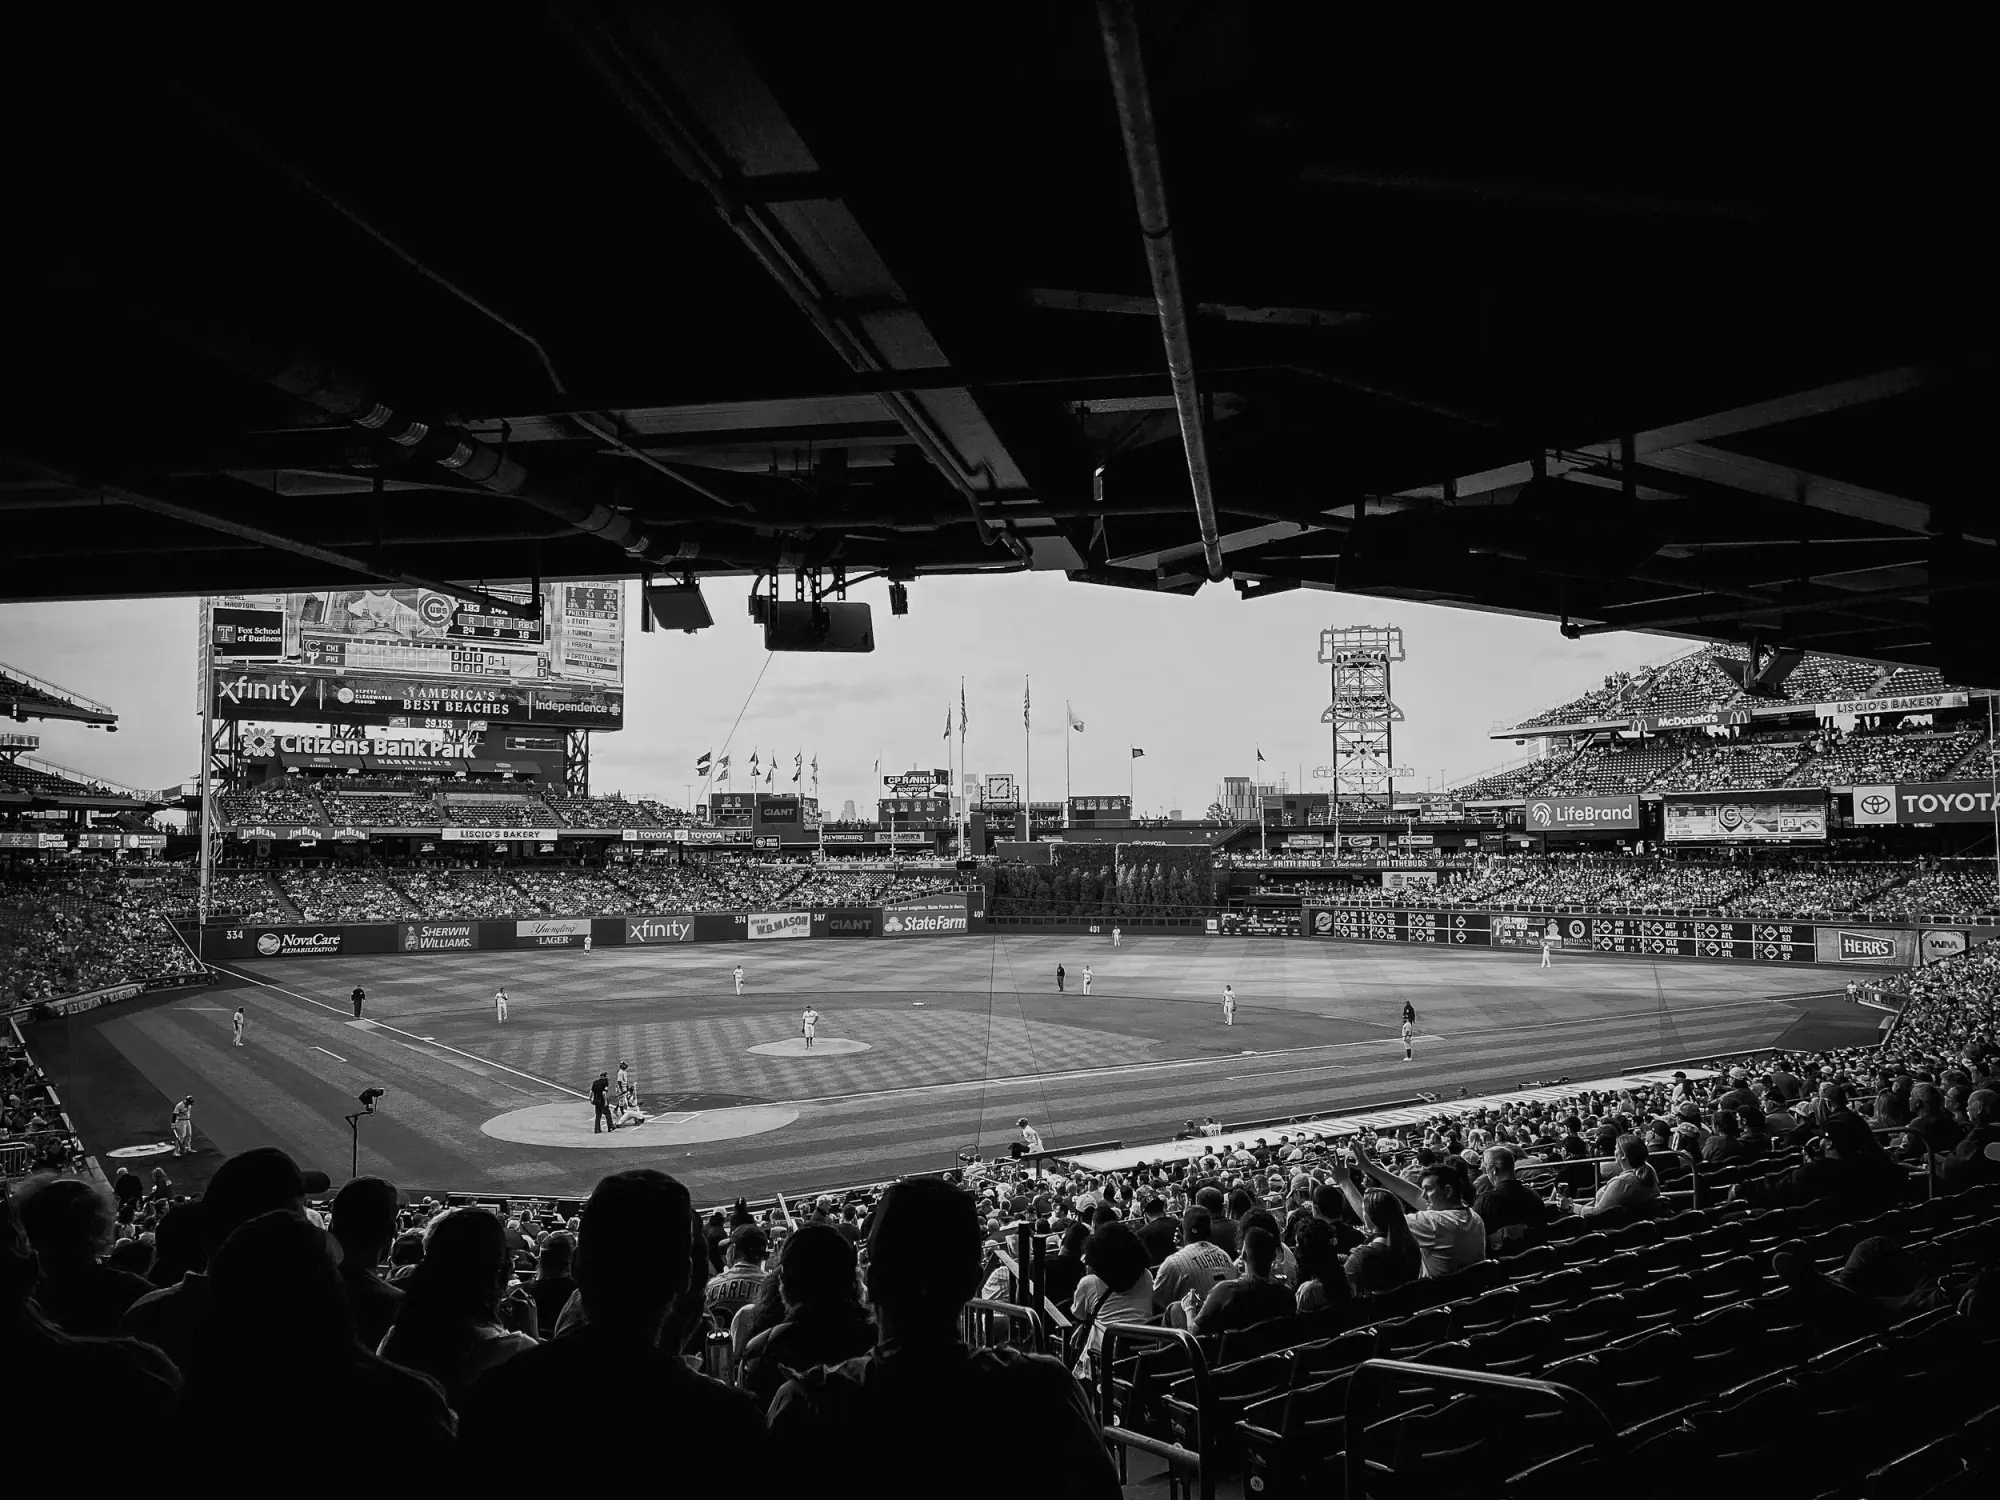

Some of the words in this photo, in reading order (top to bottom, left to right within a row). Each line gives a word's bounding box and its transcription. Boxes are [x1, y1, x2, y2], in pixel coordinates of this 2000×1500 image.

[224, 601, 257, 609] MADRIGAL
[463, 604, 480, 612] 193
[254, 627, 281, 635] School
[248, 635, 282, 643] Business
[571, 642, 593, 650] HARPER
[218, 676, 307, 707] xfinity
[418, 687, 496, 702] AMERICA'S
[403, 699, 440, 711] BEST
[445, 701, 510, 715] BEACHES
[535, 700, 608, 713] Independence
[1836, 700, 1889, 713] LISCIO'S
[1891, 695, 1943, 710] BAKERY
[1658, 713, 1719, 727] McDonald's
[280, 734, 370, 755] Citizens
[373, 738, 428, 757] Bank
[430, 739, 476, 759] Park
[902, 776, 937, 784] RANKIN
[763, 808, 795, 816] GIANT
[1556, 804, 1633, 822] LifeBrand
[241, 829, 255, 839] JIM
[256, 826, 277, 839] BEAM
[287, 829, 302, 840] JIM
[302, 827, 322, 839] BEAM
[332, 829, 346, 840] JIM
[347, 827, 366, 840] BEAM
[460, 830, 500, 838] LISCIO'S
[639, 831, 673, 839] TOYOTA
[690, 832, 723, 840] TOYOTA
[530, 921, 577, 935] Yuengling
[629, 919, 691, 942] xfinity
[829, 920, 871, 930] GIANT
[226, 931, 243, 940] 334
[420, 926, 470, 938] SHERWIN
[281, 933, 341, 946] NovaCare
[538, 936, 569, 945] LAGER
[1930, 940, 1959, 949] WM
[281, 946, 338, 954] REHABILITATION
[1844, 939, 1889, 955] HERR'S
[1192, 1253, 1234, 1269] TURNER
